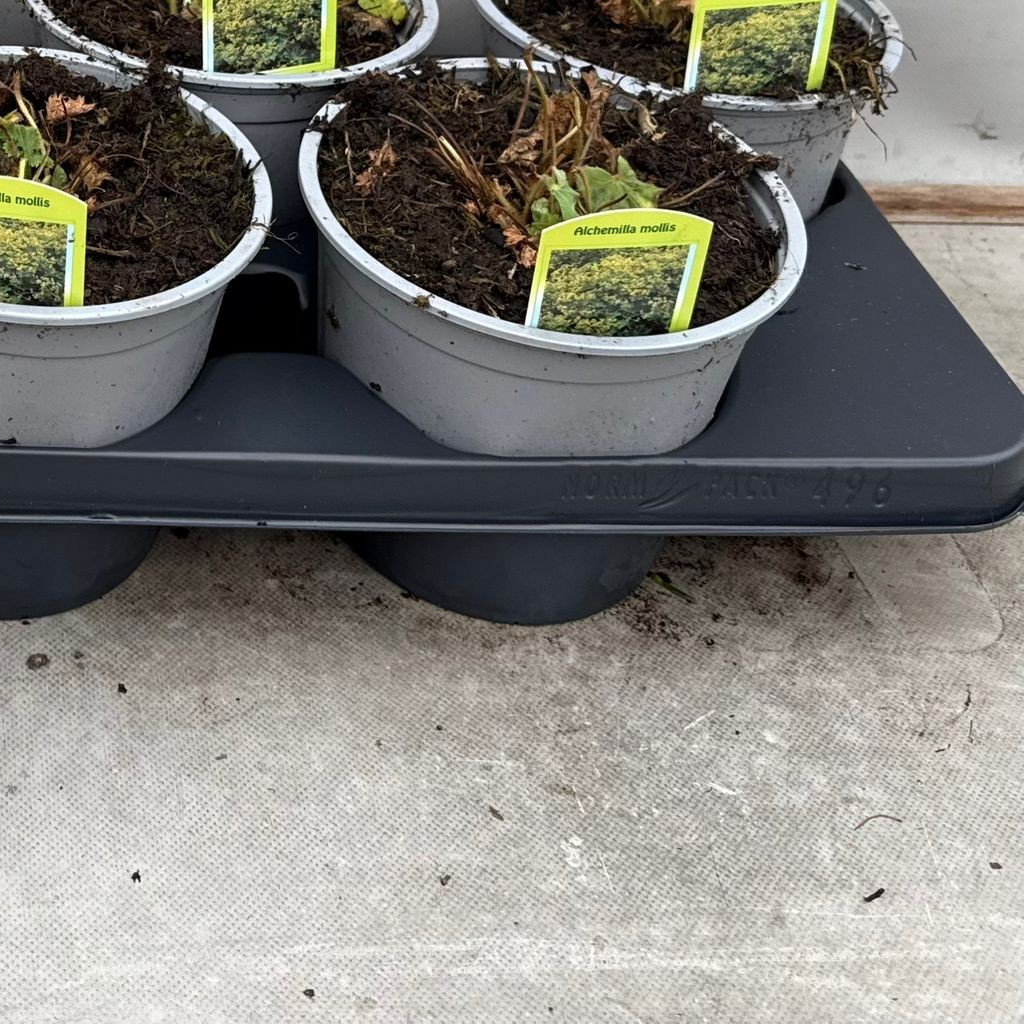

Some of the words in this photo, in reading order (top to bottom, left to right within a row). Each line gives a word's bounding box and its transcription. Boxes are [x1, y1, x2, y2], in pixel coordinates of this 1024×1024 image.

[15, 194, 51, 208] mollis
[573, 224, 637, 236] Alchemilla
[639, 222, 677, 234] mollis
[561, 470, 647, 500] NORM
[812, 467, 893, 509] 496
